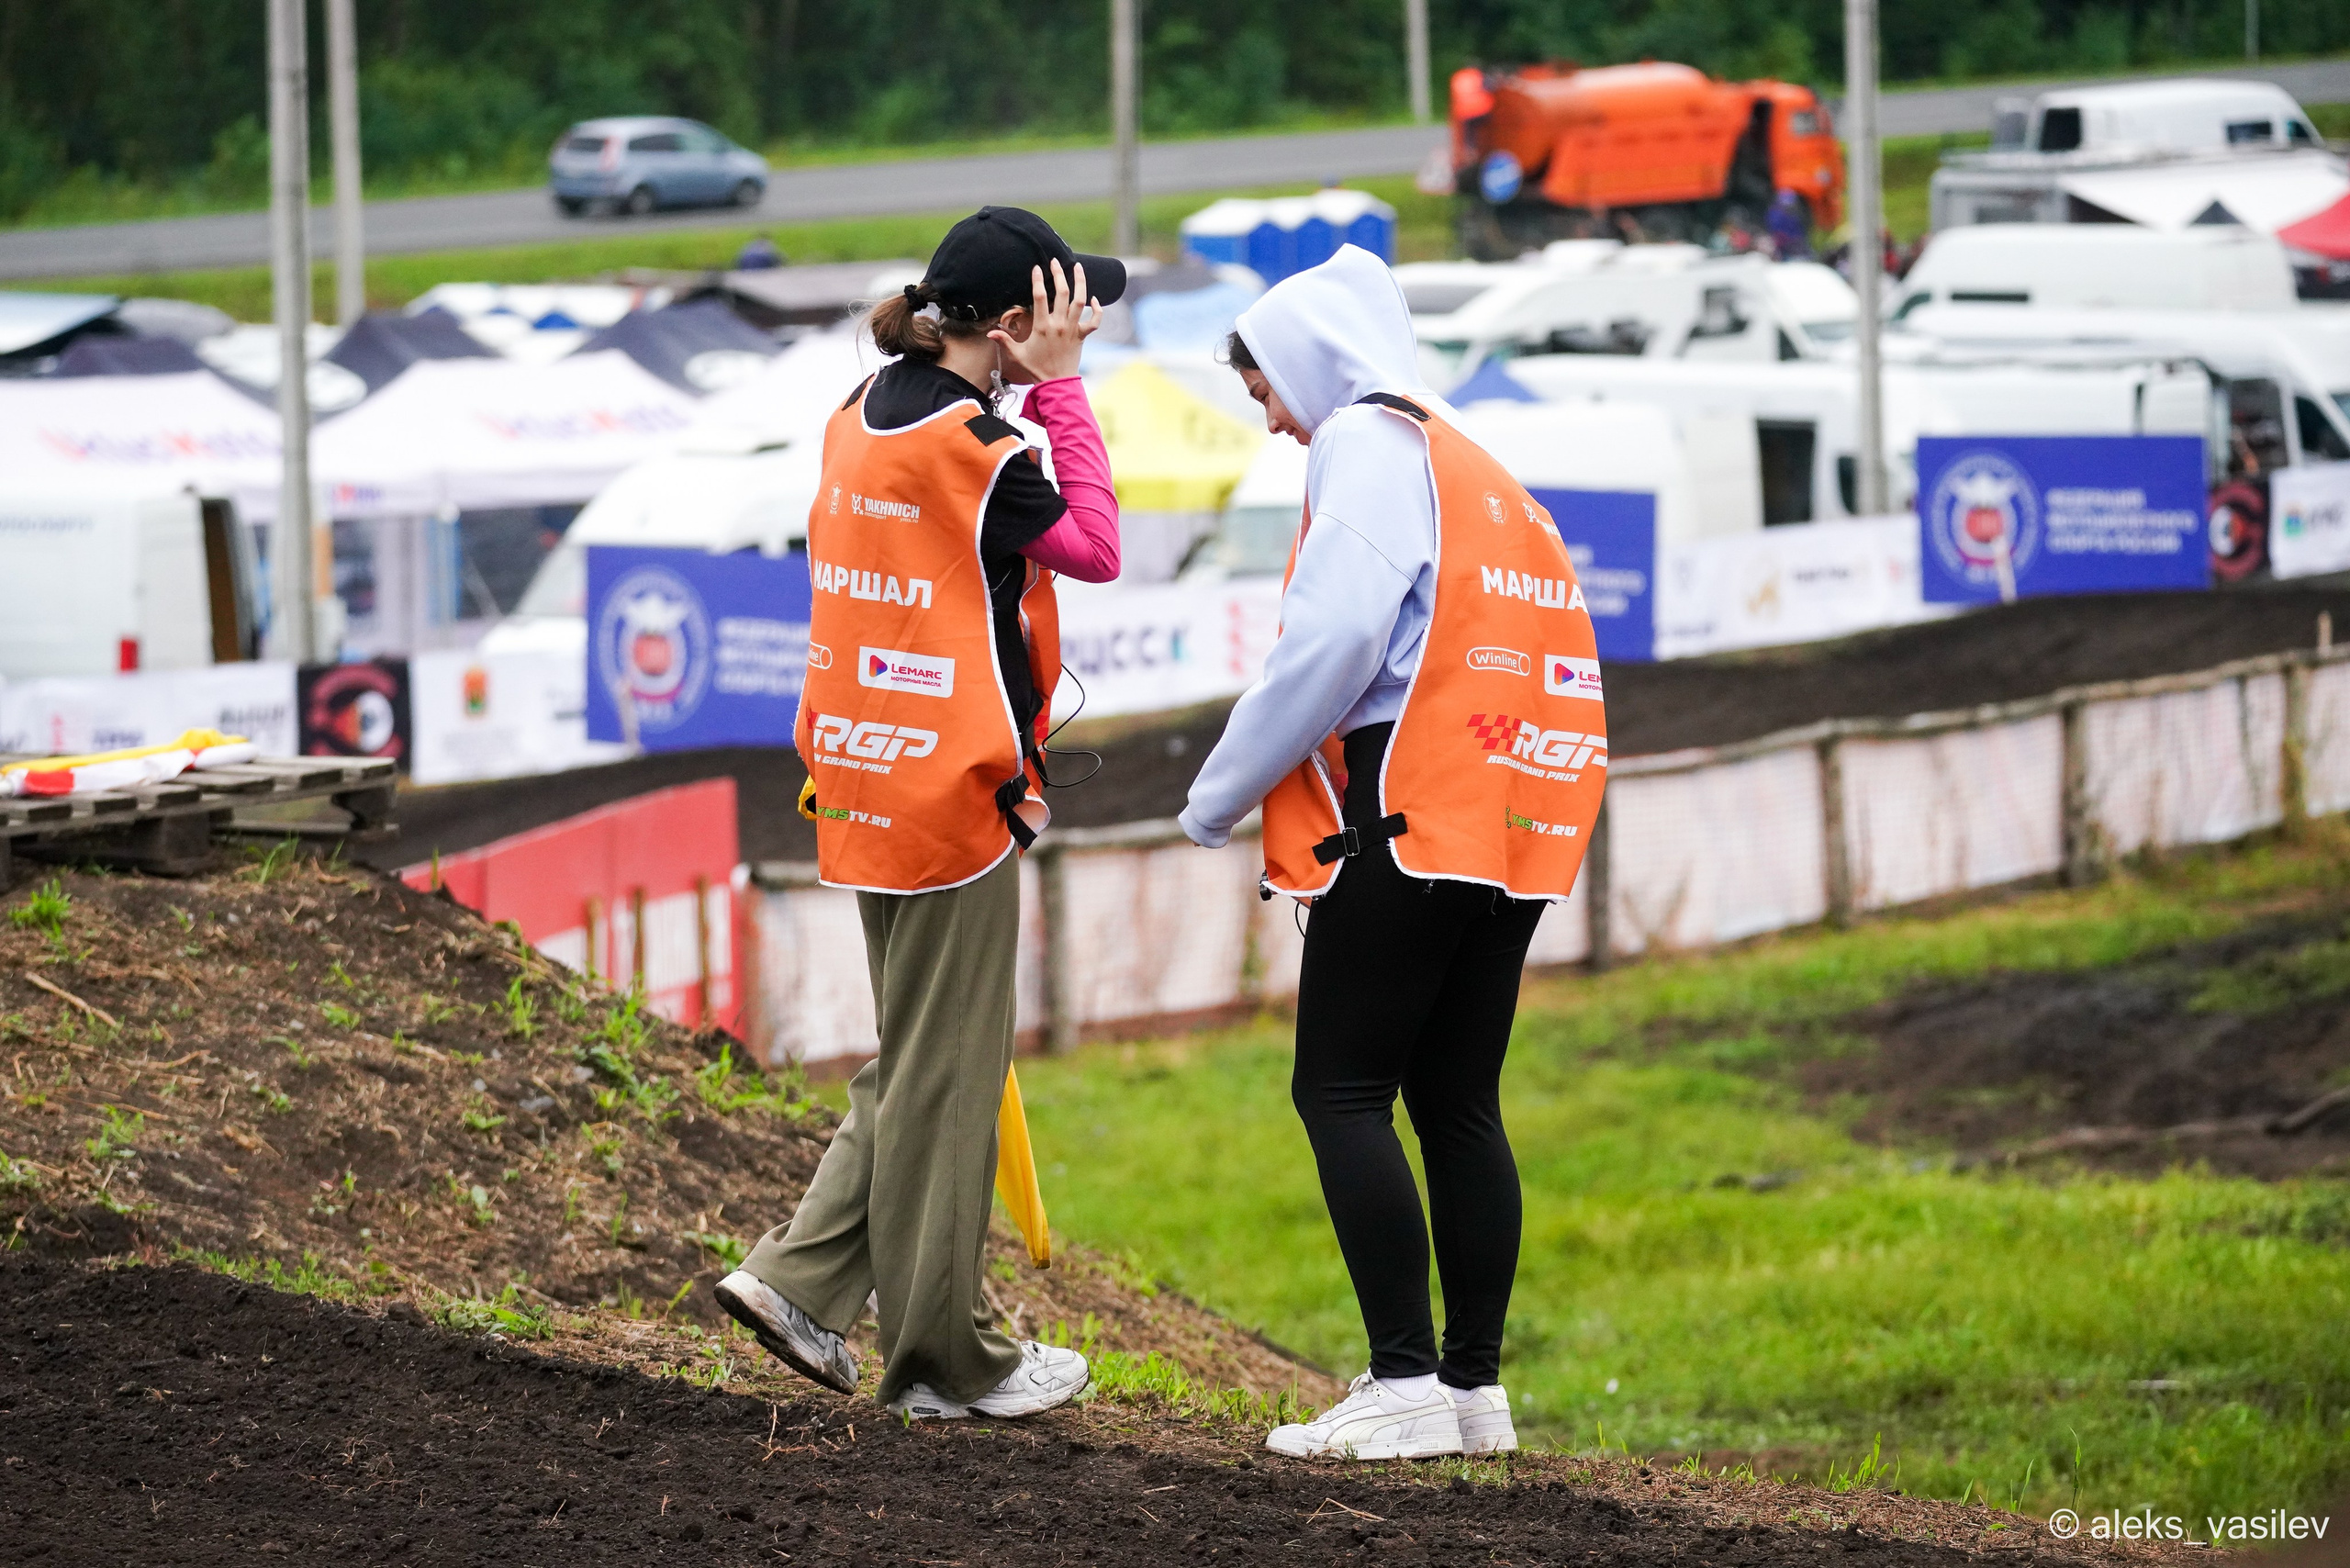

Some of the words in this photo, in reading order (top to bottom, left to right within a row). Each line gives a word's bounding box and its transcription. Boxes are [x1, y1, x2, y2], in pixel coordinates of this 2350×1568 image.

[864, 497, 921, 520] YAKHNICH
[813, 558, 933, 610] МАРШАЛ
[1474, 652, 1517, 668] Winline
[890, 676, 922, 685] МОТОРНЫЕ
[891, 663, 943, 680] LEMARC
[813, 713, 939, 762] RGP
[1511, 720, 1608, 770] RGP
[822, 756, 861, 769] GRAND
[861, 762, 893, 775] PRIX
[1519, 763, 1546, 778] GRAND
[1546, 770, 1581, 783] PRIX
[816, 806, 892, 828] YMSTV.RU
[1512, 813, 1578, 837] YMSTV.RU
